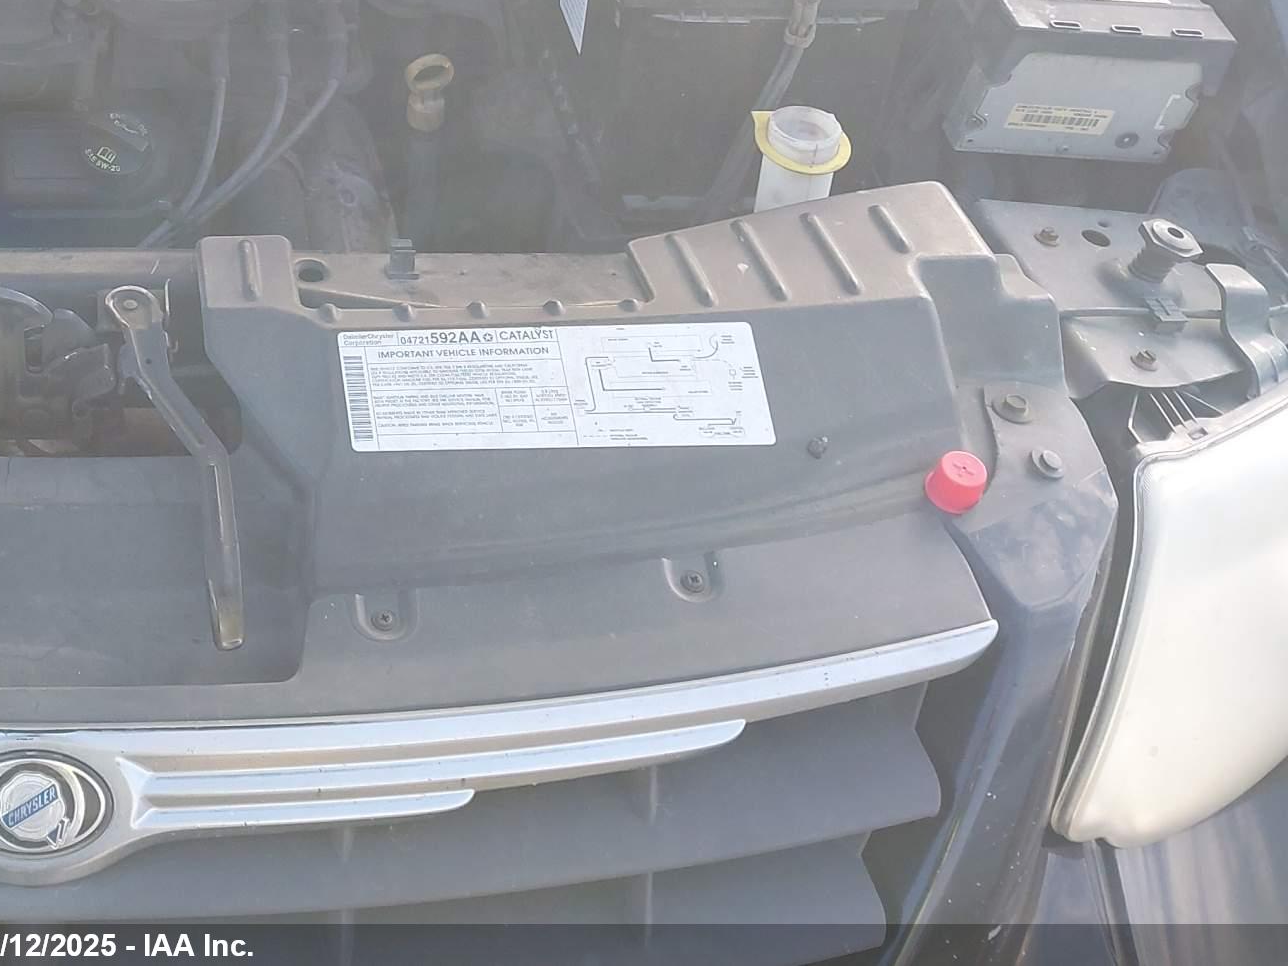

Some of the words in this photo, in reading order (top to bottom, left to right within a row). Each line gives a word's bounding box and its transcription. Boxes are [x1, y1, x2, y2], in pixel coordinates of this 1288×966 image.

[400, 331, 481, 345] 04721592AA
[499, 329, 554, 341] CATALYST
[378, 349, 435, 359] IMPORTANT
[436, 348, 477, 357] VEHICLE
[479, 346, 549, 356] INFORMATION
[8, 785, 57, 828] CHRYSLER
